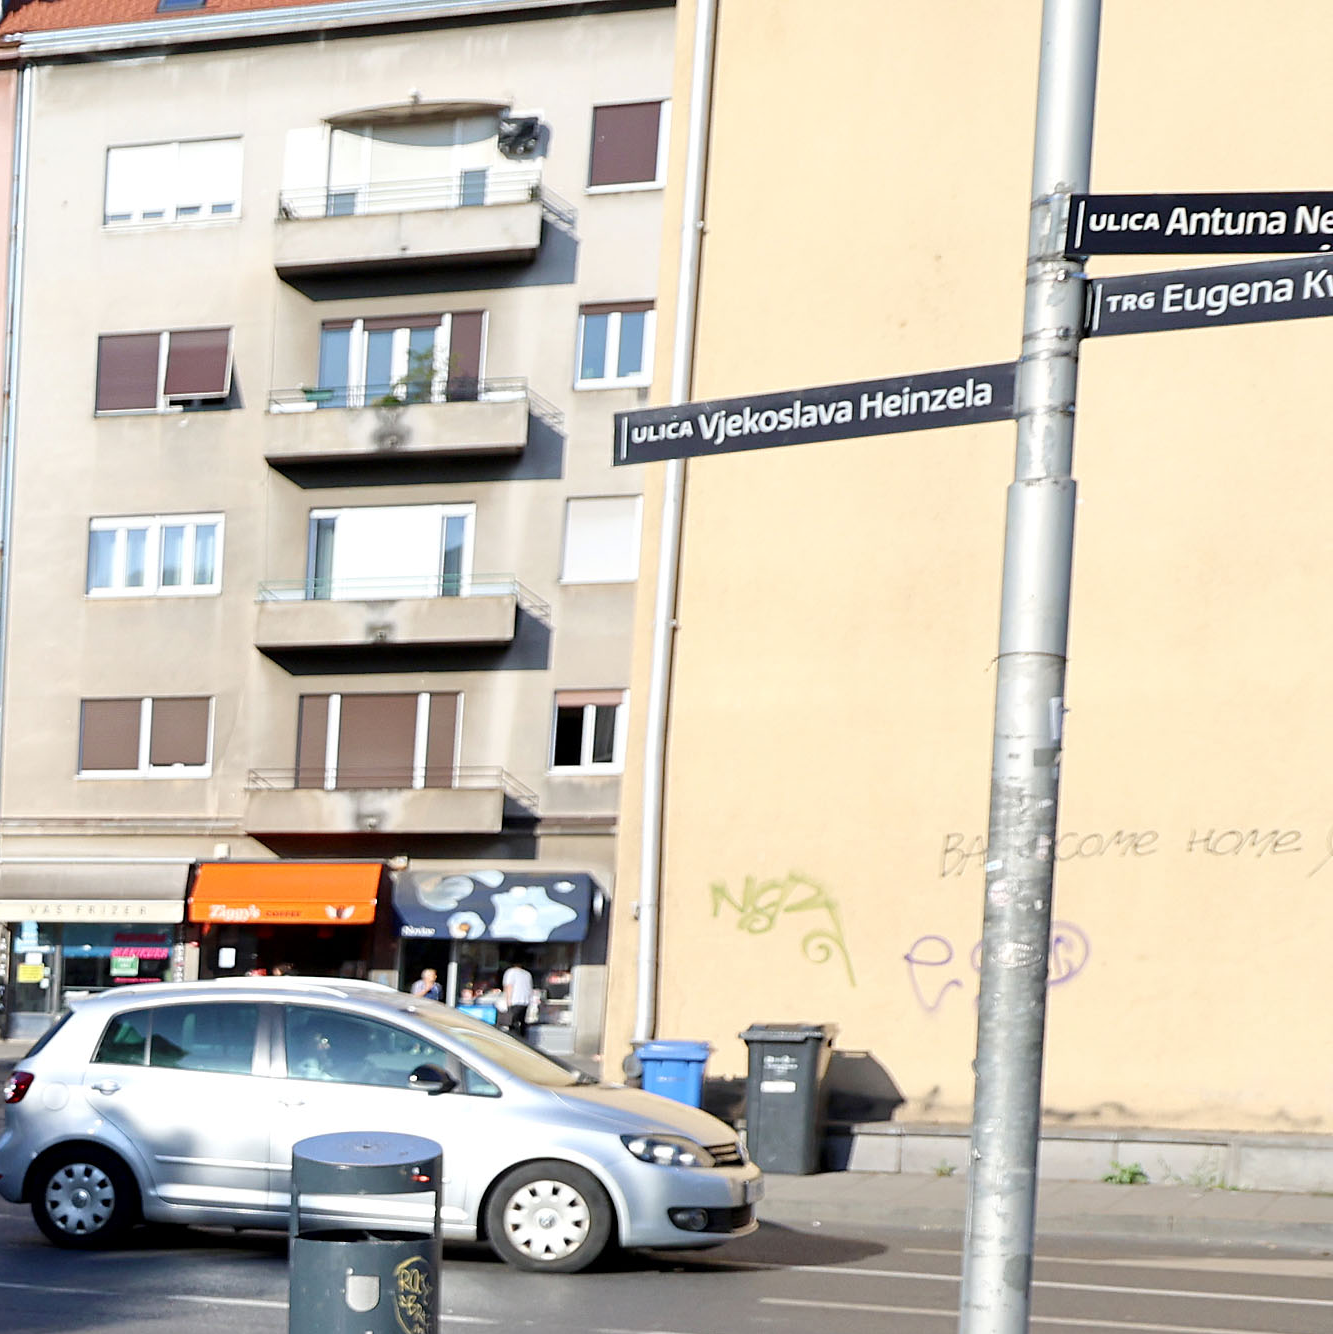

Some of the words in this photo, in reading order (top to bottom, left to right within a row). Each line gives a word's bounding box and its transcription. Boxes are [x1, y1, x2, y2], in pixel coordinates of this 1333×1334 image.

[1088, 212, 1161, 233] ULICA
[1165, 205, 1288, 237] Antuna
[1105, 289, 1155, 314] TRG
[1162, 274, 1295, 316] Eugena
[631, 417, 694, 445] ULICA
[698, 398, 853, 446] Vjekoslava
[859, 378, 993, 421] Heinzela
[1185, 826, 1303, 860] HOME
[75, 904, 147, 916] FRIZER
